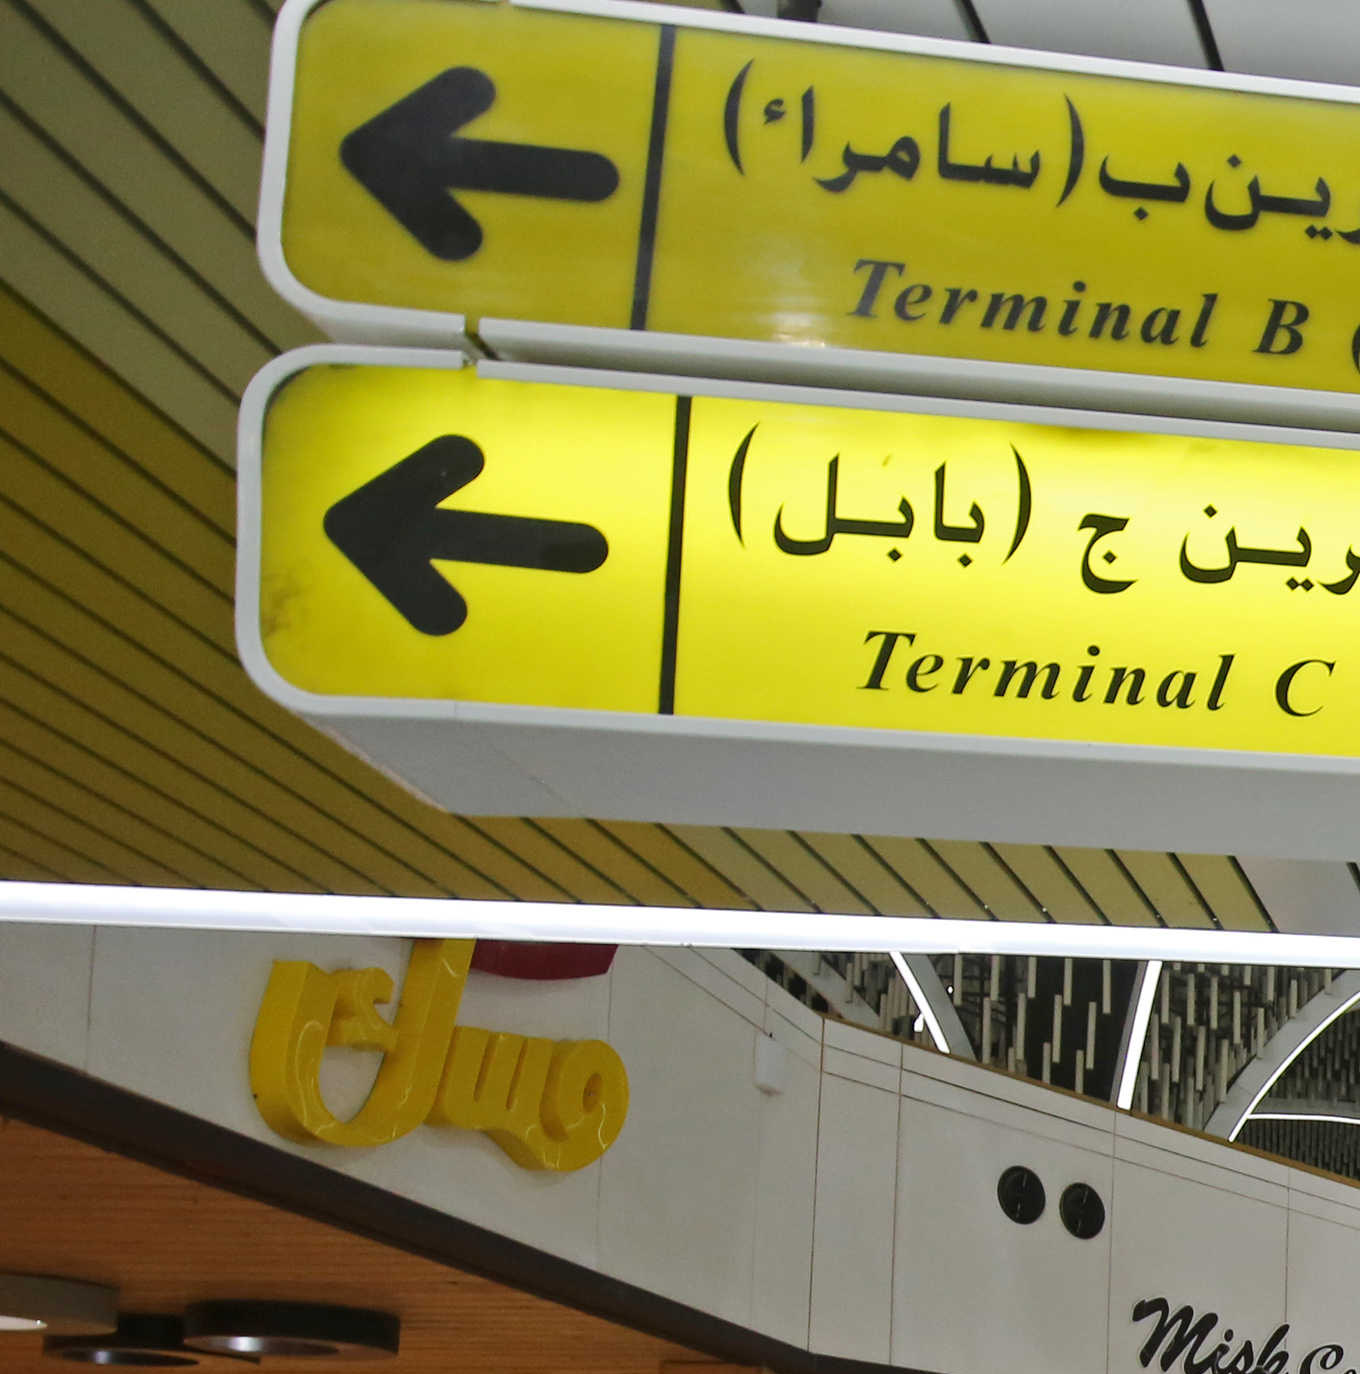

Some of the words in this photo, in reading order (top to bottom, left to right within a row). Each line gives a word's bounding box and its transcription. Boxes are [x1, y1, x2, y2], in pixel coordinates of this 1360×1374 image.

[853, 260, 1218, 348] Terminal
[1254, 299, 1309, 355] B
[729, 425, 1031, 567] (بابل)
[1078, 514, 1136, 594] ج
[862, 631, 1234, 711] Terminal
[1276, 660, 1335, 717] C
